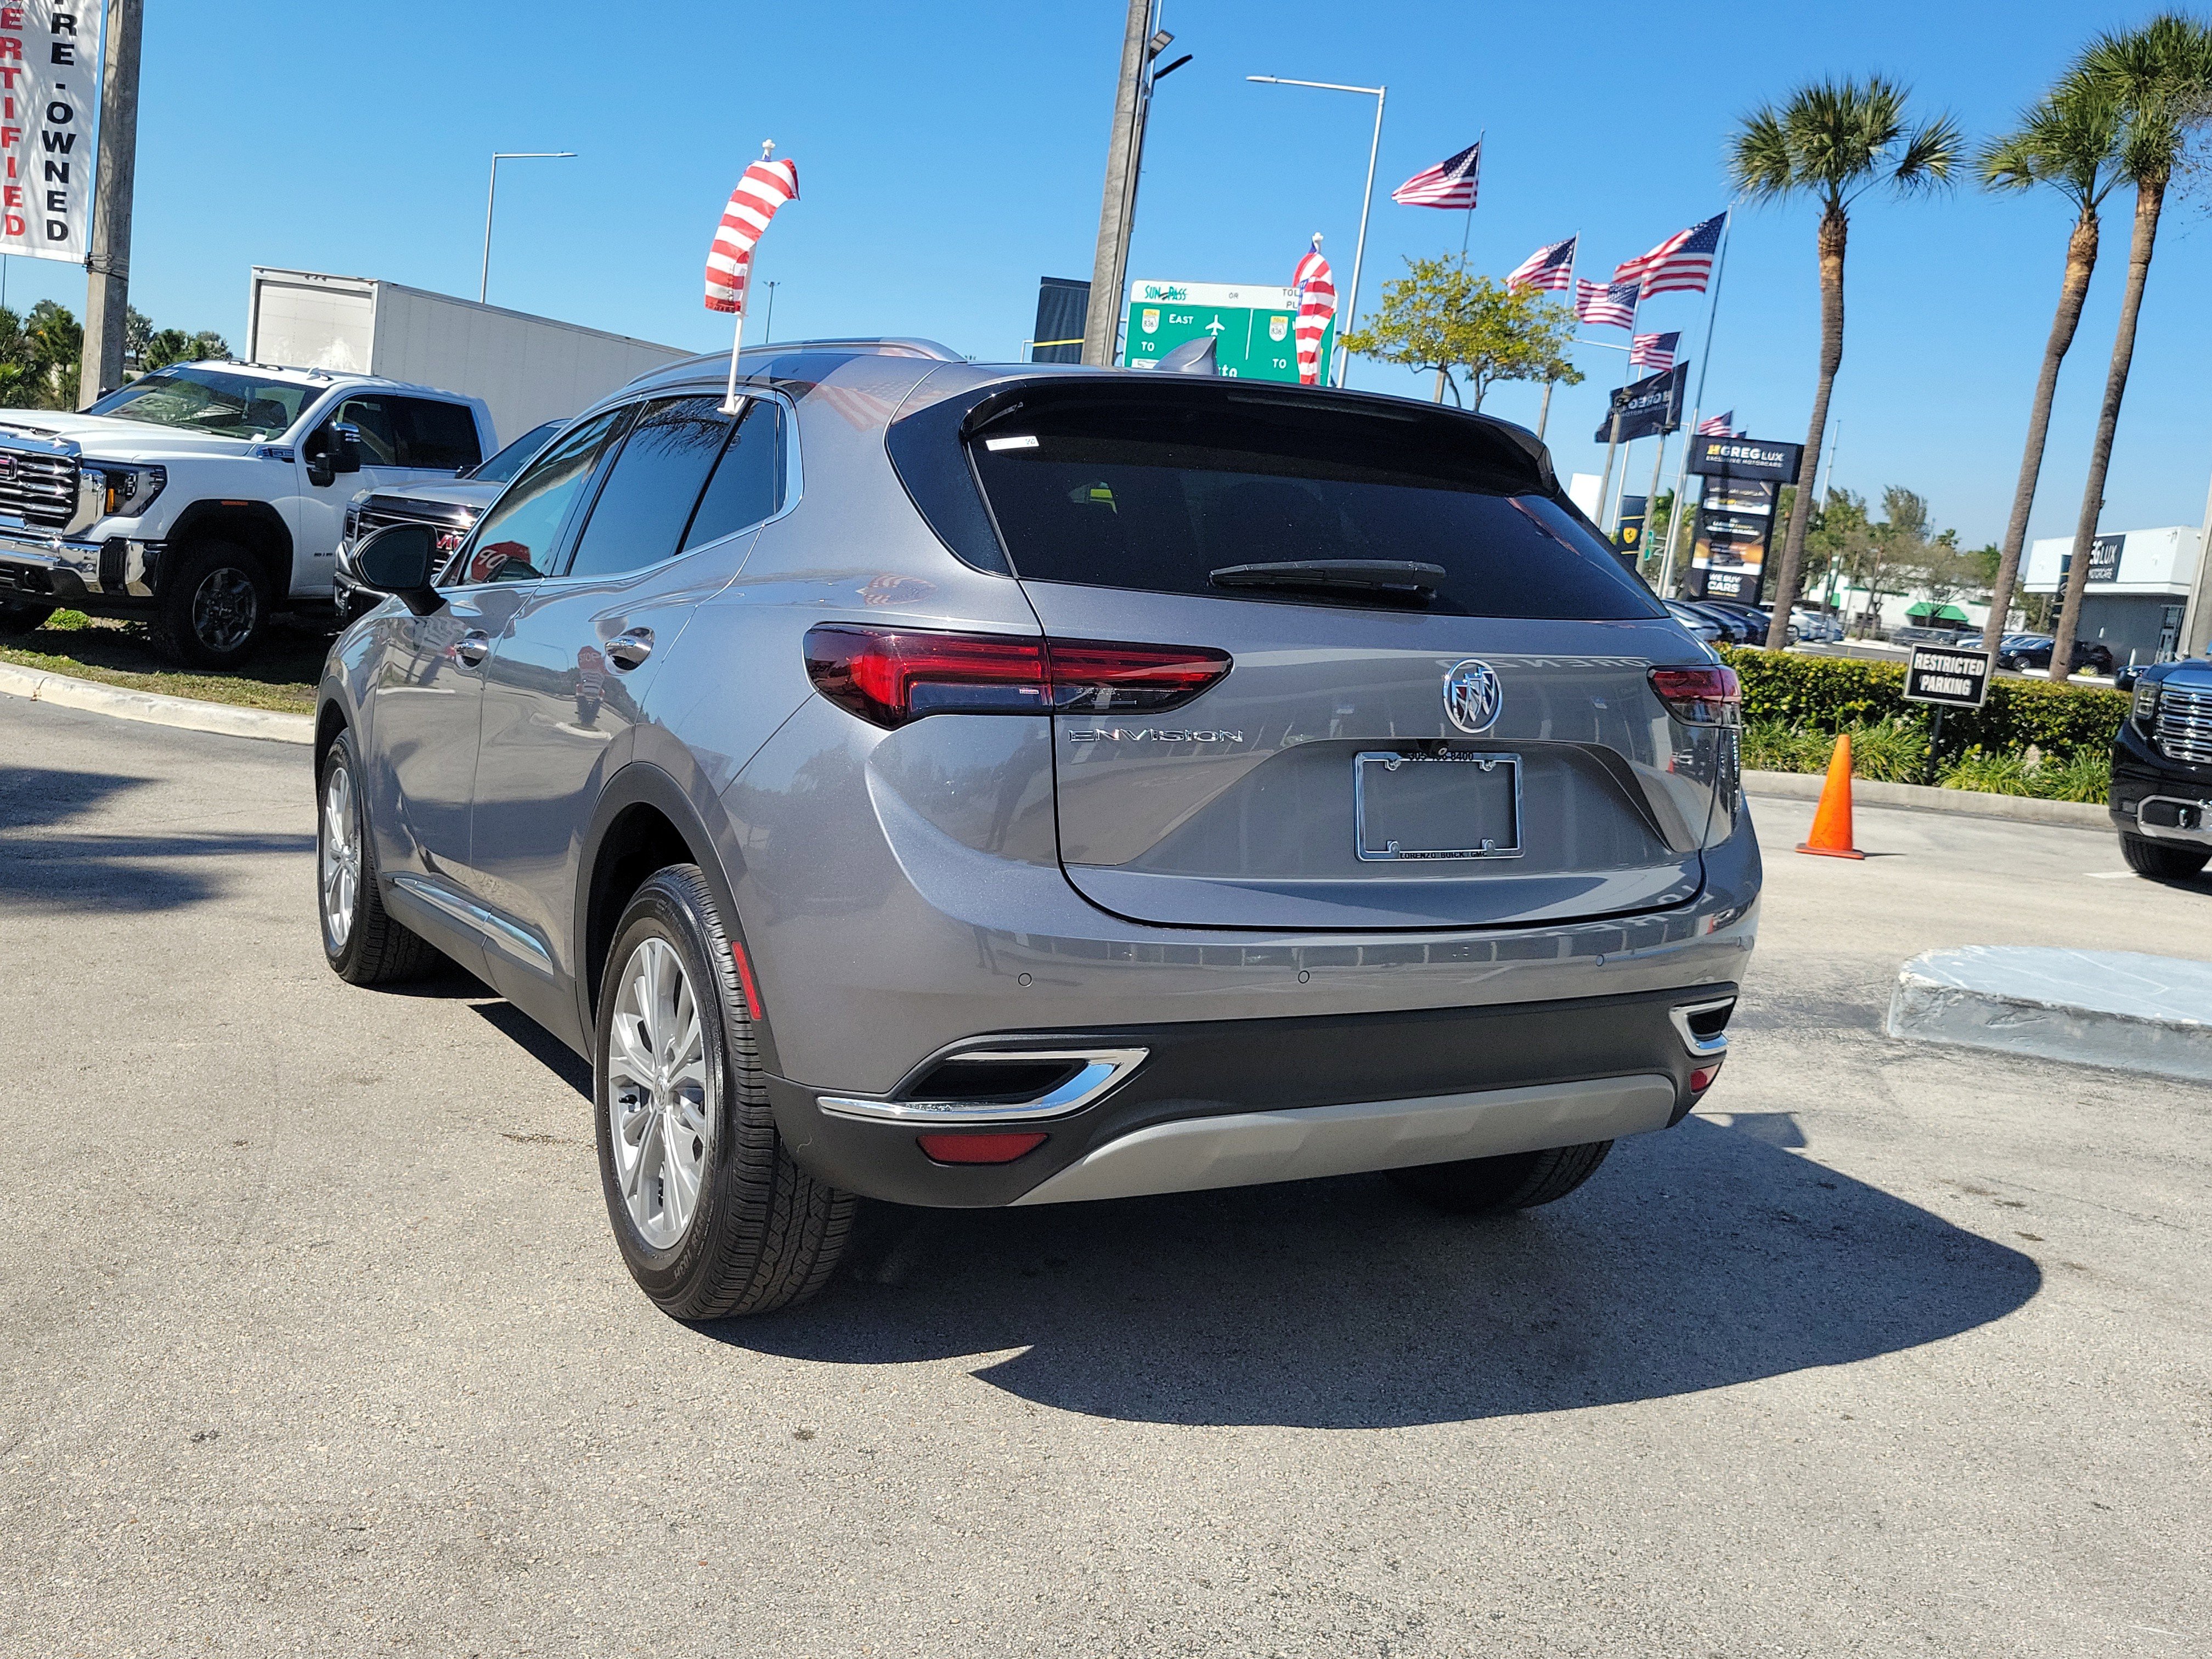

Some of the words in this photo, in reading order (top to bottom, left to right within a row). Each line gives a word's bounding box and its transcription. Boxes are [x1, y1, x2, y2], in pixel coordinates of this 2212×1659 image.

[0, 0, 26, 236] ERTIFIED
[42, 0, 77, 241] RE-OWNED
[1228, 291, 1239, 300] OR
[1169, 313, 1194, 325] EAST
[1141, 341, 1155, 352] TO
[1272, 358, 1287, 369] TO
[1709, 573, 1723, 582] WE
[1723, 574, 1742, 583] BUY
[1707, 580, 1741, 593] CARS
[1914, 652, 1986, 676] RESTRICTED
[1919, 674, 1973, 696] PARKING
[1068, 728, 1243, 742] ENVISION
